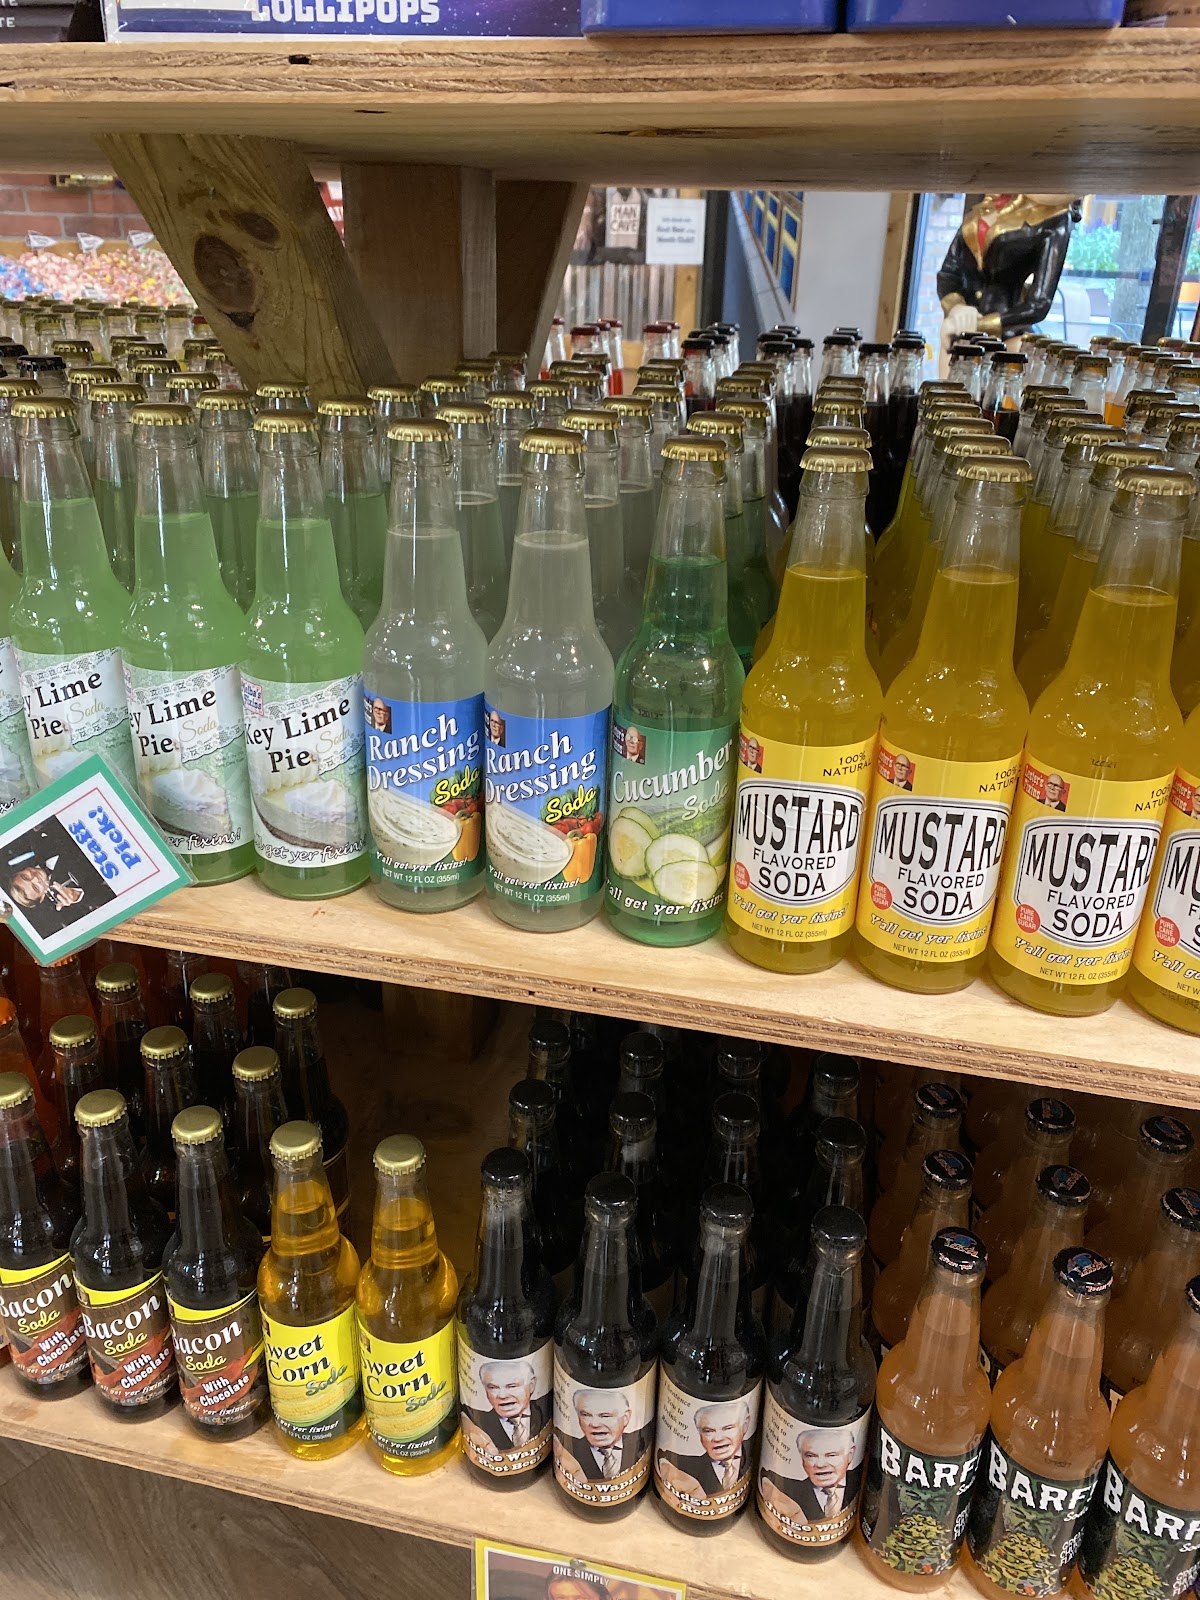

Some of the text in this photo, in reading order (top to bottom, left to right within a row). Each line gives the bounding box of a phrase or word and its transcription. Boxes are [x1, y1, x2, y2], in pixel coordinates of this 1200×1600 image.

[251, 0, 440, 23] LOLLIPOPS
[35, 672, 102, 707] Lime
[66, 700, 104, 724] Soda
[147, 690, 216, 725] Lime
[30, 717, 63, 739] Pie
[178, 716, 218, 742] Soda
[244, 723, 274, 750] Key
[281, 698, 350, 739] Lime
[139, 734, 174, 757] Pie
[316, 729, 353, 755] Soda
[369, 713, 460, 762] Ranch
[268, 750, 311, 774] Pie
[368, 730, 480, 790] Dressing
[486, 730, 573, 774] Ranch
[839, 751, 867, 766] 100%
[485, 748, 597, 803] Dressing
[613, 738, 734, 803] Cucumber
[822, 757, 872, 777] NATURAL
[434, 765, 479, 805] Soda
[545, 784, 597, 823] Soda
[681, 780, 728, 821] Soda
[738, 793, 860, 854] MUSTARD
[68, 819, 119, 880] Staff
[187, 827, 241, 849] fixins!
[265, 844, 289, 859] get
[288, 849, 318, 864] yer
[320, 833, 367, 863] fixins!
[878, 811, 1007, 872] MUSTARD
[433, 857, 468, 872] fixins!
[752, 848, 836, 870] FLAVORED
[382, 867, 460, 884] NET WT 12 FL OZ (355ml)
[543, 877, 580, 890] fixins!
[758, 866, 827, 897] SODA
[897, 866, 985, 889] FLAVORED
[493, 881, 570, 903] NET WT 12 FL OZ (355ml)
[903, 886, 973, 917] SODA
[1047, 889, 1136, 911] FLAVORED
[624, 896, 648, 911] get
[653, 904, 685, 916] yer
[734, 893, 849, 924] Y'all get yer fixins!
[1020, 906, 1035, 916] PURE
[1020, 913, 1034, 923] CANE
[752, 922, 763, 931] NET
[764, 926, 774, 935] WT
[776, 929, 784, 937] 12
[805, 929, 827, 938] (355ml)
[870, 913, 953, 944] Y'all get yer
[1018, 918, 1037, 930] SUGAR
[1052, 909, 1123, 939] SODA
[1158, 926, 1174, 937] CANE
[1159, 919, 1175, 930] PURE
[1156, 932, 1176, 944] SUGAR
[893, 943, 906, 952] NET
[907, 945, 918, 955] WT
[920, 949, 929, 957] 12
[930, 950, 938, 958] FL
[940, 950, 948, 958] OZ
[1015, 936, 1102, 967] Y'all get yer
[1152, 950, 1184, 973] Y'all
[1040, 967, 1053, 976] NET
[1055, 969, 1067, 979] WT
[1069, 972, 1078, 980] 12
[1177, 981, 1191, 993] NET
[18, 1309, 61, 1334] Soda
[82, 1295, 161, 1339] Bacon
[39, 1331, 66, 1352] With
[104, 1330, 147, 1356] Soda
[266, 1334, 324, 1361] weet
[121, 1348, 170, 1389] Chocolate
[123, 1354, 152, 1374] With
[186, 1353, 227, 1371] Soda
[269, 1356, 331, 1382] Corn
[199, 1375, 249, 1407] Chocolate
[202, 1377, 230, 1394] With
[305, 1365, 348, 1396] Soda
[366, 1372, 431, 1398] Corn
[405, 1380, 447, 1413] Soda
[678, 1420, 689, 1431] my
[780, 1441, 791, 1452] my
[478, 1456, 510, 1472] Root
[989, 1440, 1098, 1511] BARF!
[566, 1481, 634, 1503] Root Beer
[664, 1480, 710, 1506] Judge
[680, 1502, 716, 1516] Root
[765, 1500, 812, 1532] Judge
[781, 1526, 817, 1542] Root
[819, 1526, 848, 1542] Beer
[552, 1565, 610, 1586] ONE SIMPLY
